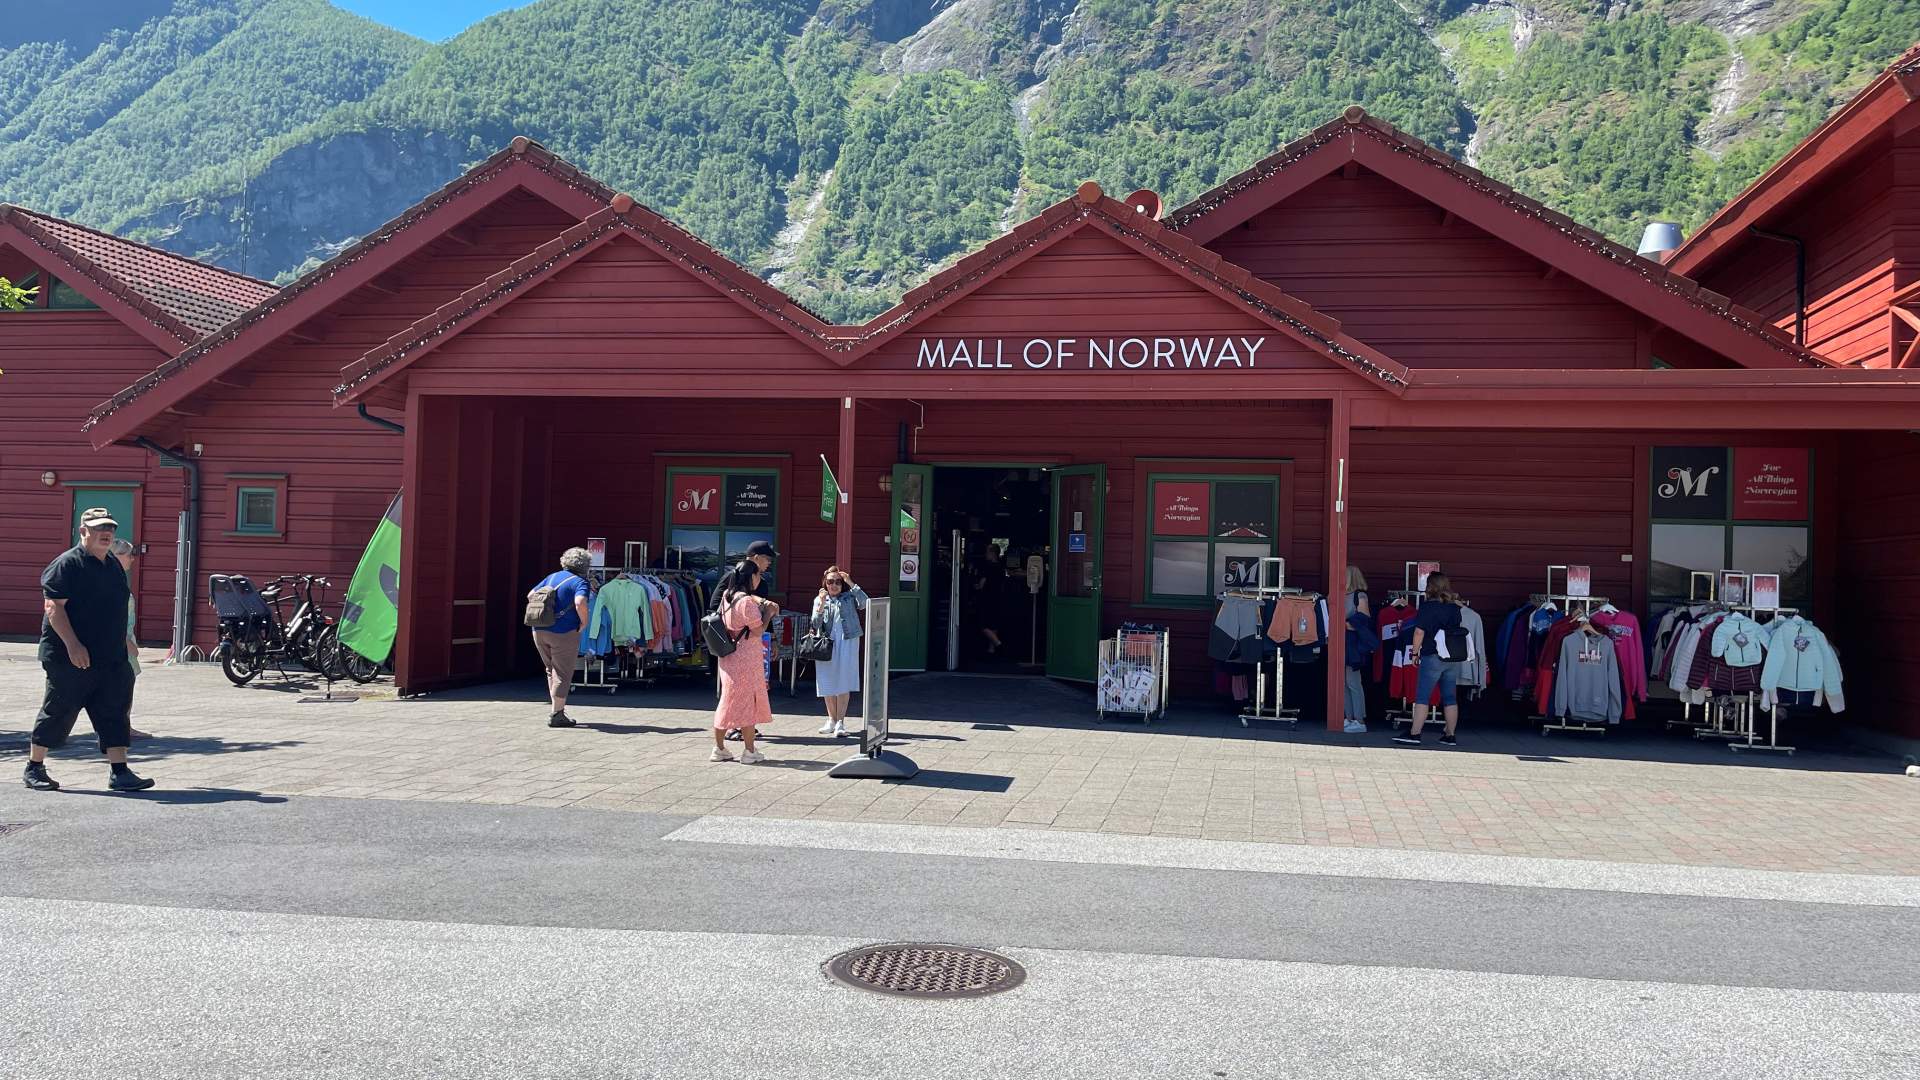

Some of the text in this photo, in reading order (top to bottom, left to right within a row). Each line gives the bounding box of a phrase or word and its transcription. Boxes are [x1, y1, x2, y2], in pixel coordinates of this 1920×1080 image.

[916, 337, 1265, 369] MALL OF NORWAY
[1762, 464, 1782, 472] For
[1658, 466, 1720, 498] M
[1749, 474, 1795, 485] All Things
[1744, 486, 1798, 497] Norwegian
[678, 488, 717, 512] M
[735, 501, 768, 509] Norwegian
[1177, 504, 1199, 512] Things
[1163, 514, 1201, 522] Norwegian
